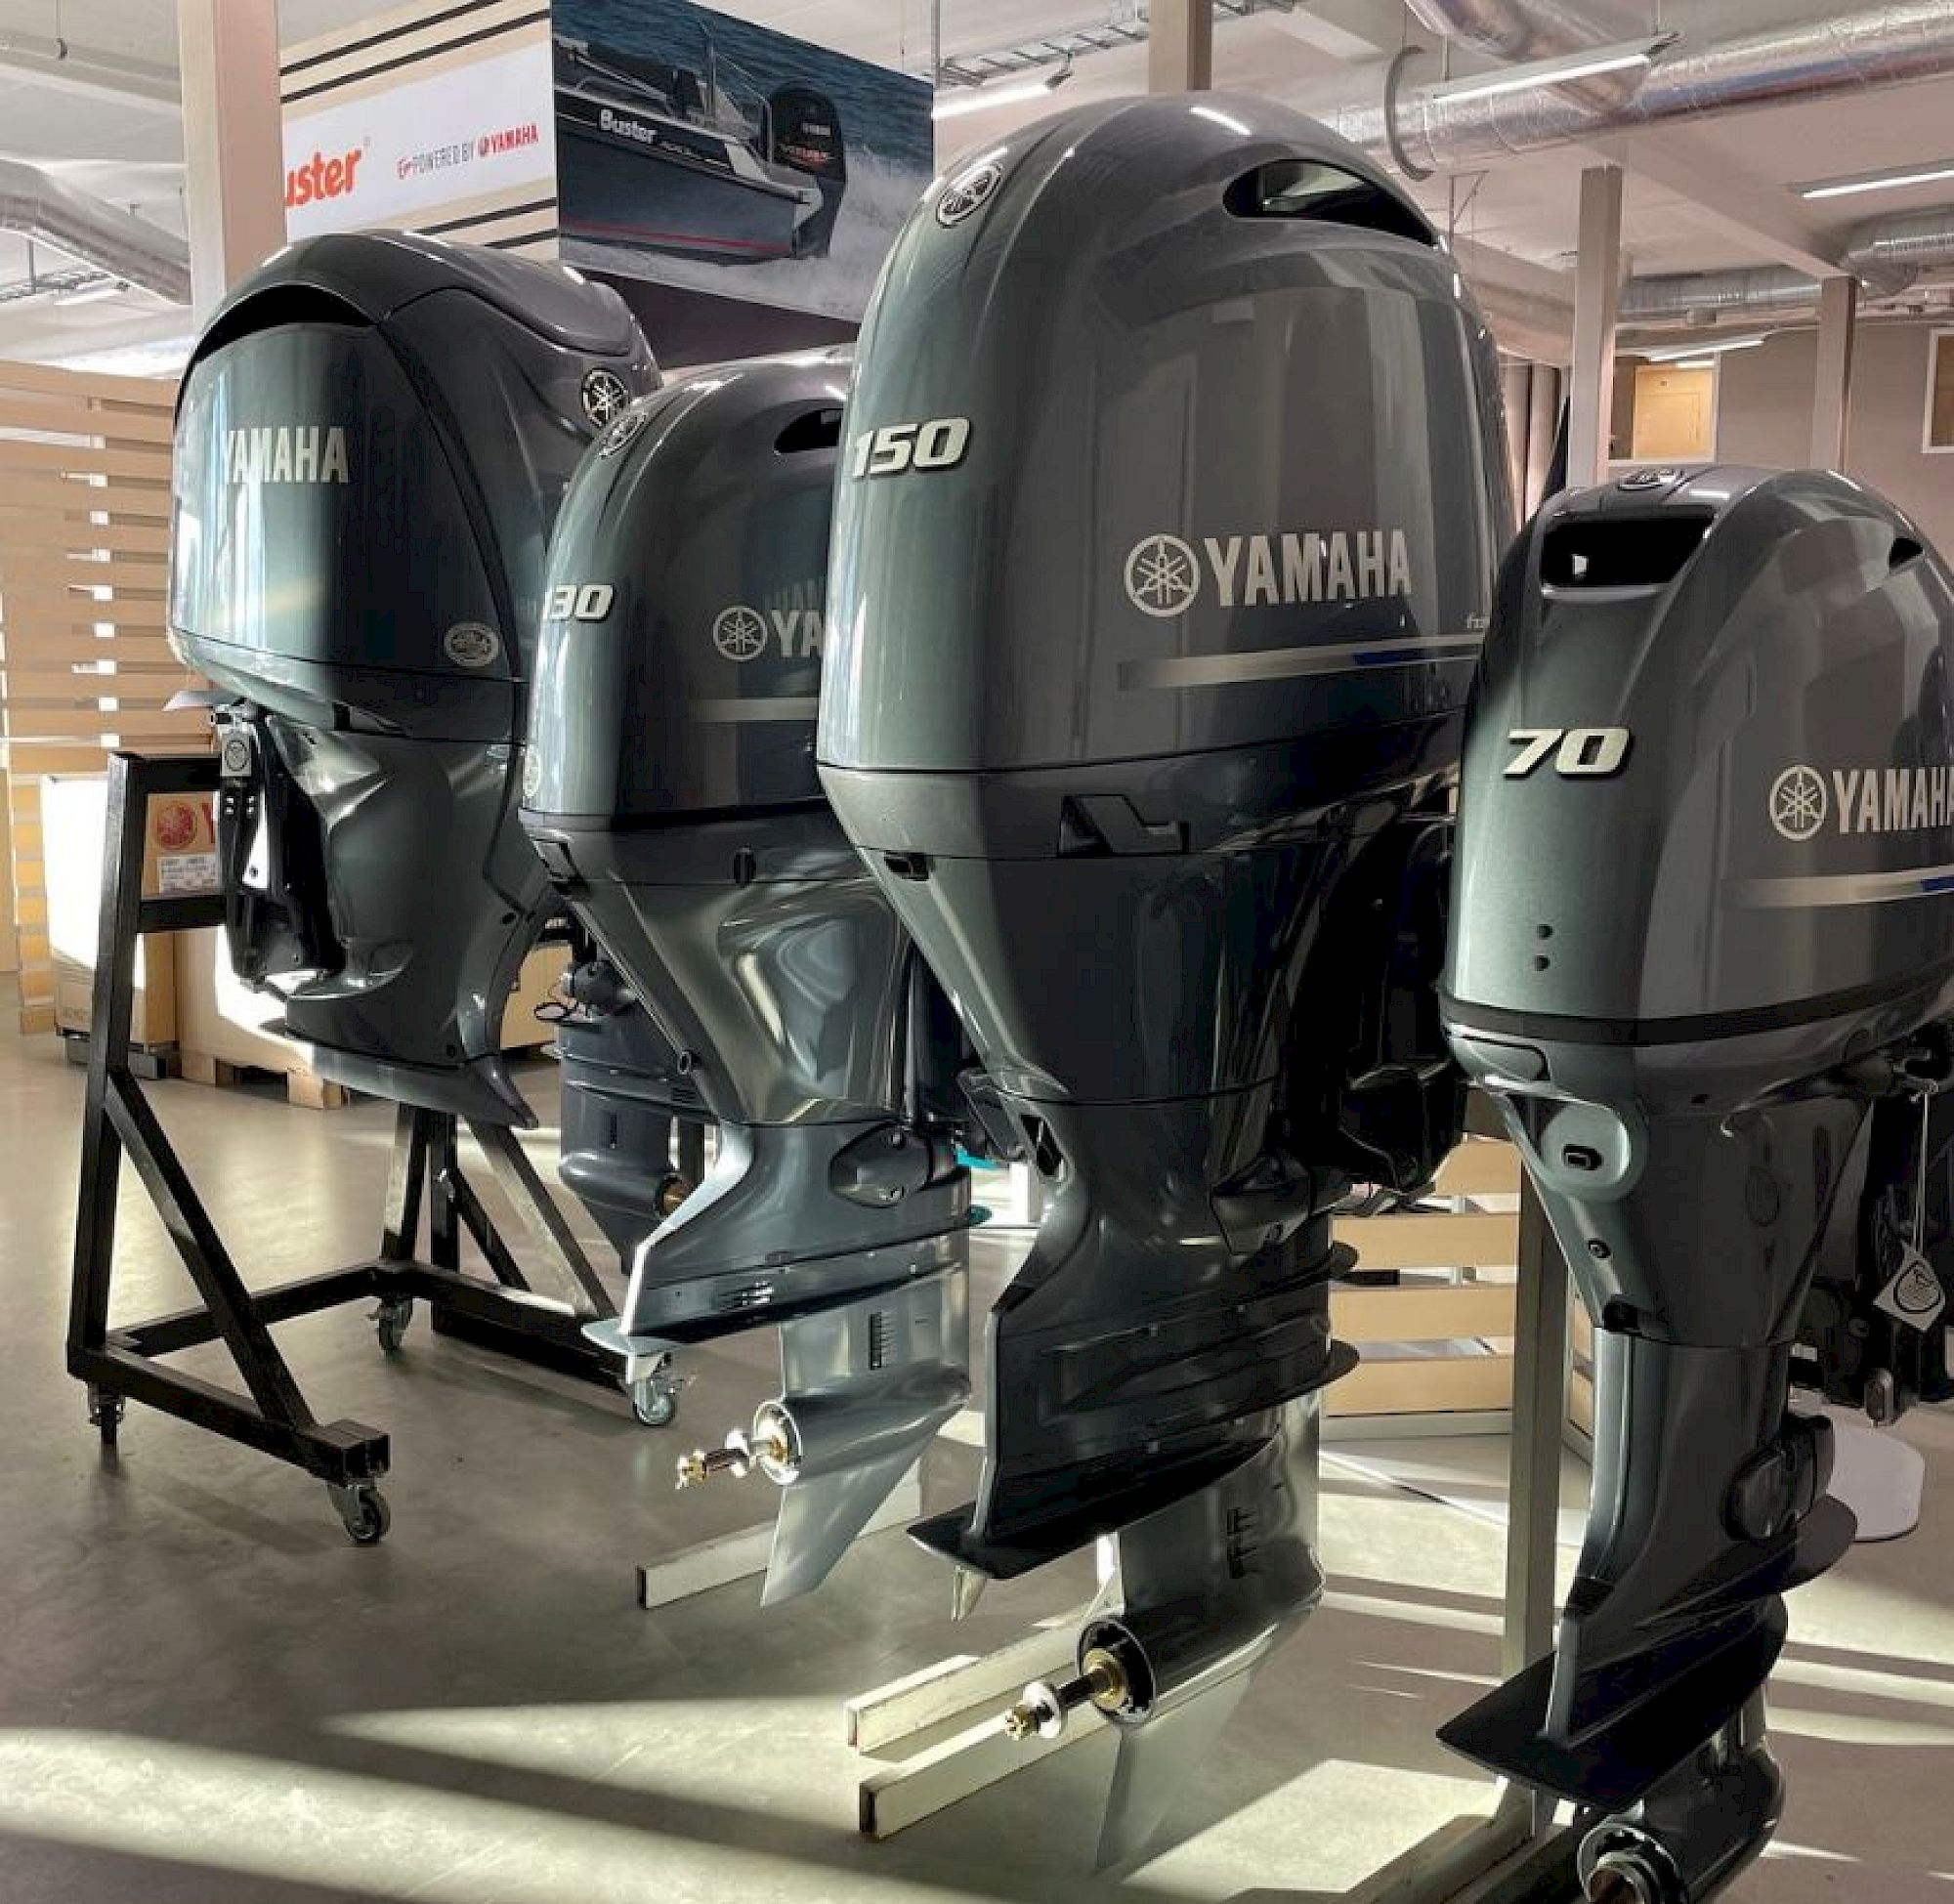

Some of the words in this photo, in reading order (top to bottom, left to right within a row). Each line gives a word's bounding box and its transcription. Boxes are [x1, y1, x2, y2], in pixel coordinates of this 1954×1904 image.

[461, 141, 477, 163] BY
[491, 122, 539, 153] YAMAHA
[600, 109, 658, 145] Buster
[221, 425, 350, 484] YAMAHA
[853, 418, 970, 477] 150
[1204, 529, 1412, 607] YAMAHA
[1502, 728, 1630, 777] 70
